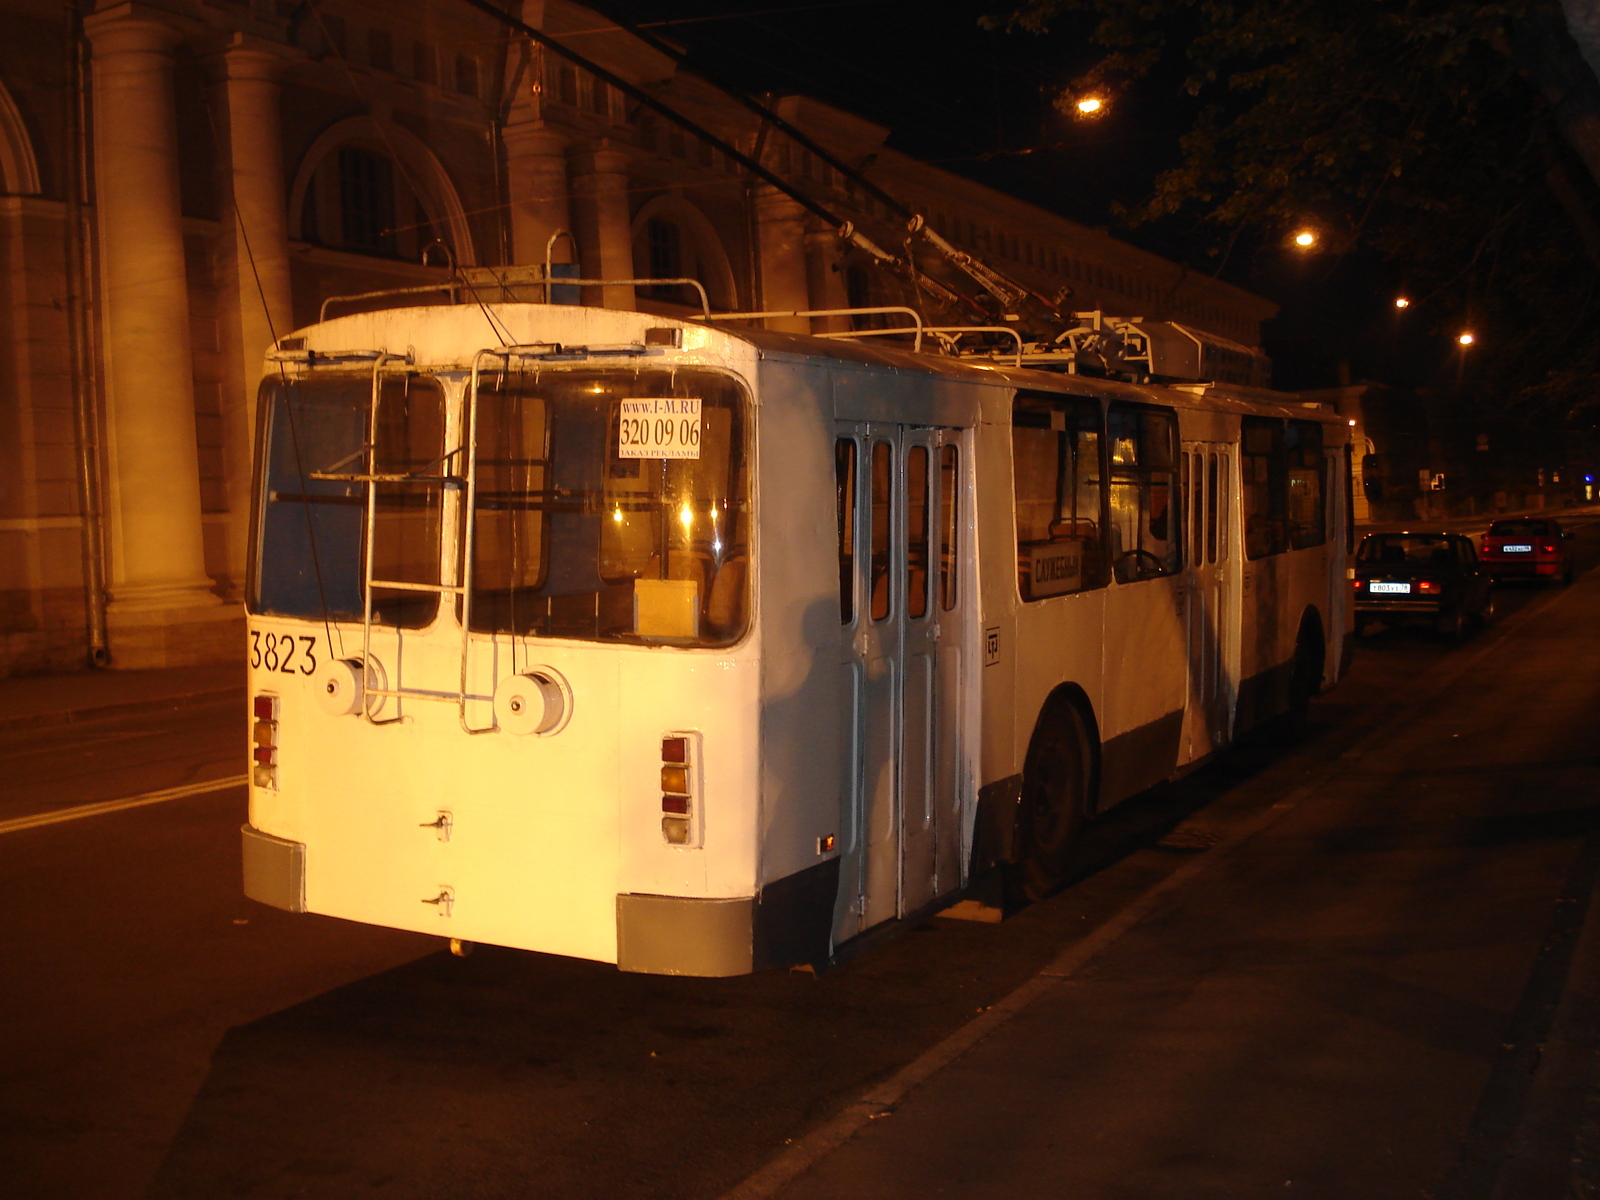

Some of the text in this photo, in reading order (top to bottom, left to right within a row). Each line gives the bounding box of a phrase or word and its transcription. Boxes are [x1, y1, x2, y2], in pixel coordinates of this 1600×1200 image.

[621, 418, 699, 446] 320 09 06
[250, 630, 317, 676] 3823
